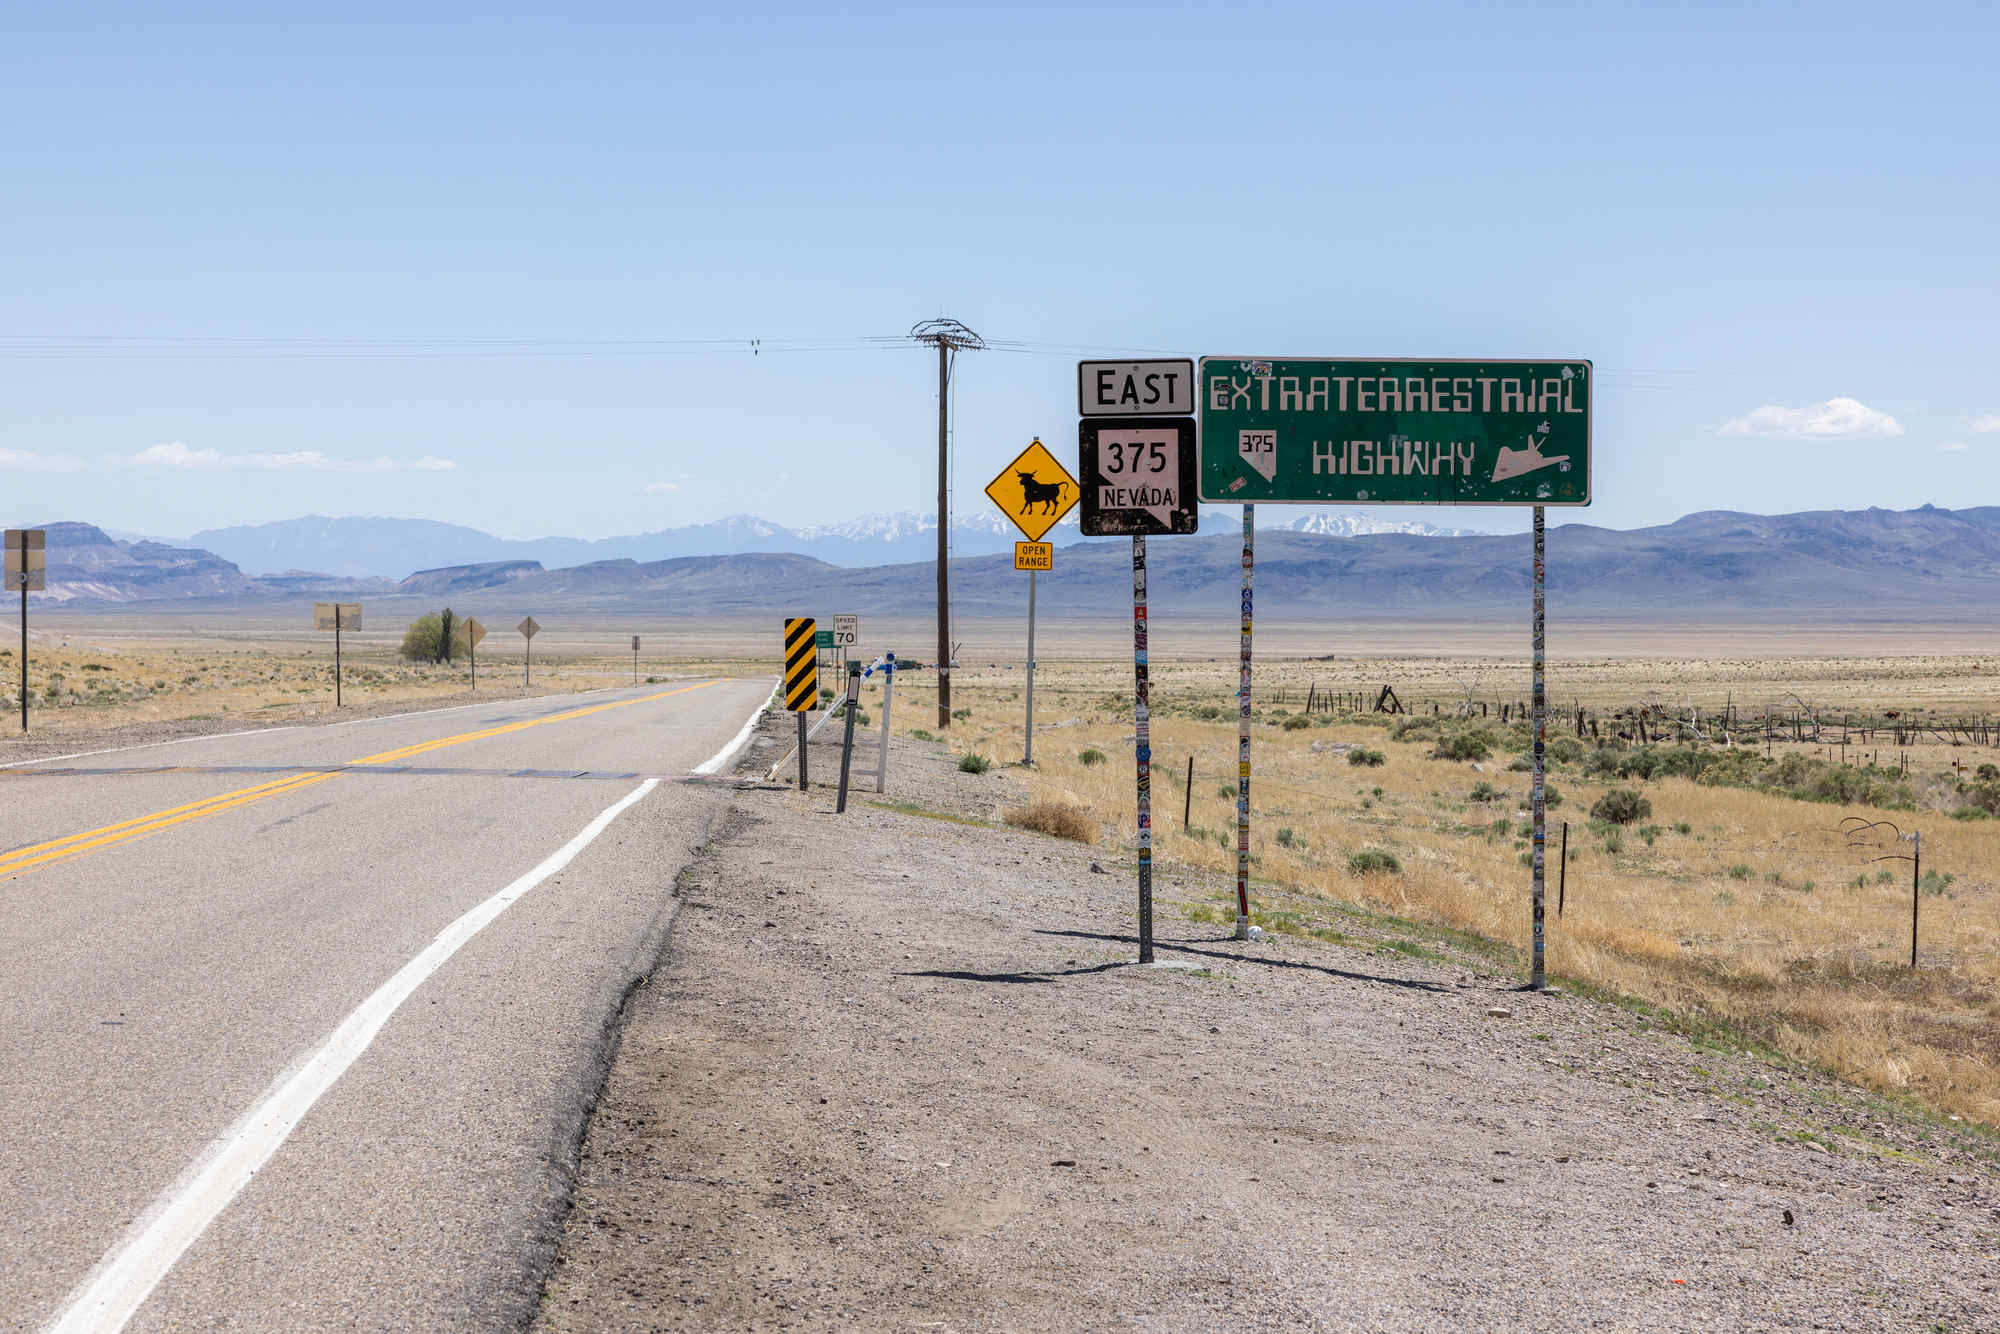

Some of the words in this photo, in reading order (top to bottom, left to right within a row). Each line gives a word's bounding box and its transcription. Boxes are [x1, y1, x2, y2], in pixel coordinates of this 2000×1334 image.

[1097, 370, 1178, 405] EAST
[1210, 376, 1583, 413] EXTRATERRESTRIAL
[1242, 435, 1273, 452] 375
[1107, 442, 1166, 473] 375
[1104, 488, 1174, 506] NEVADA
[1022, 546, 1046, 555] OPEN
[1019, 557, 1048, 567] RANGE
[836, 632, 855, 643] 70
